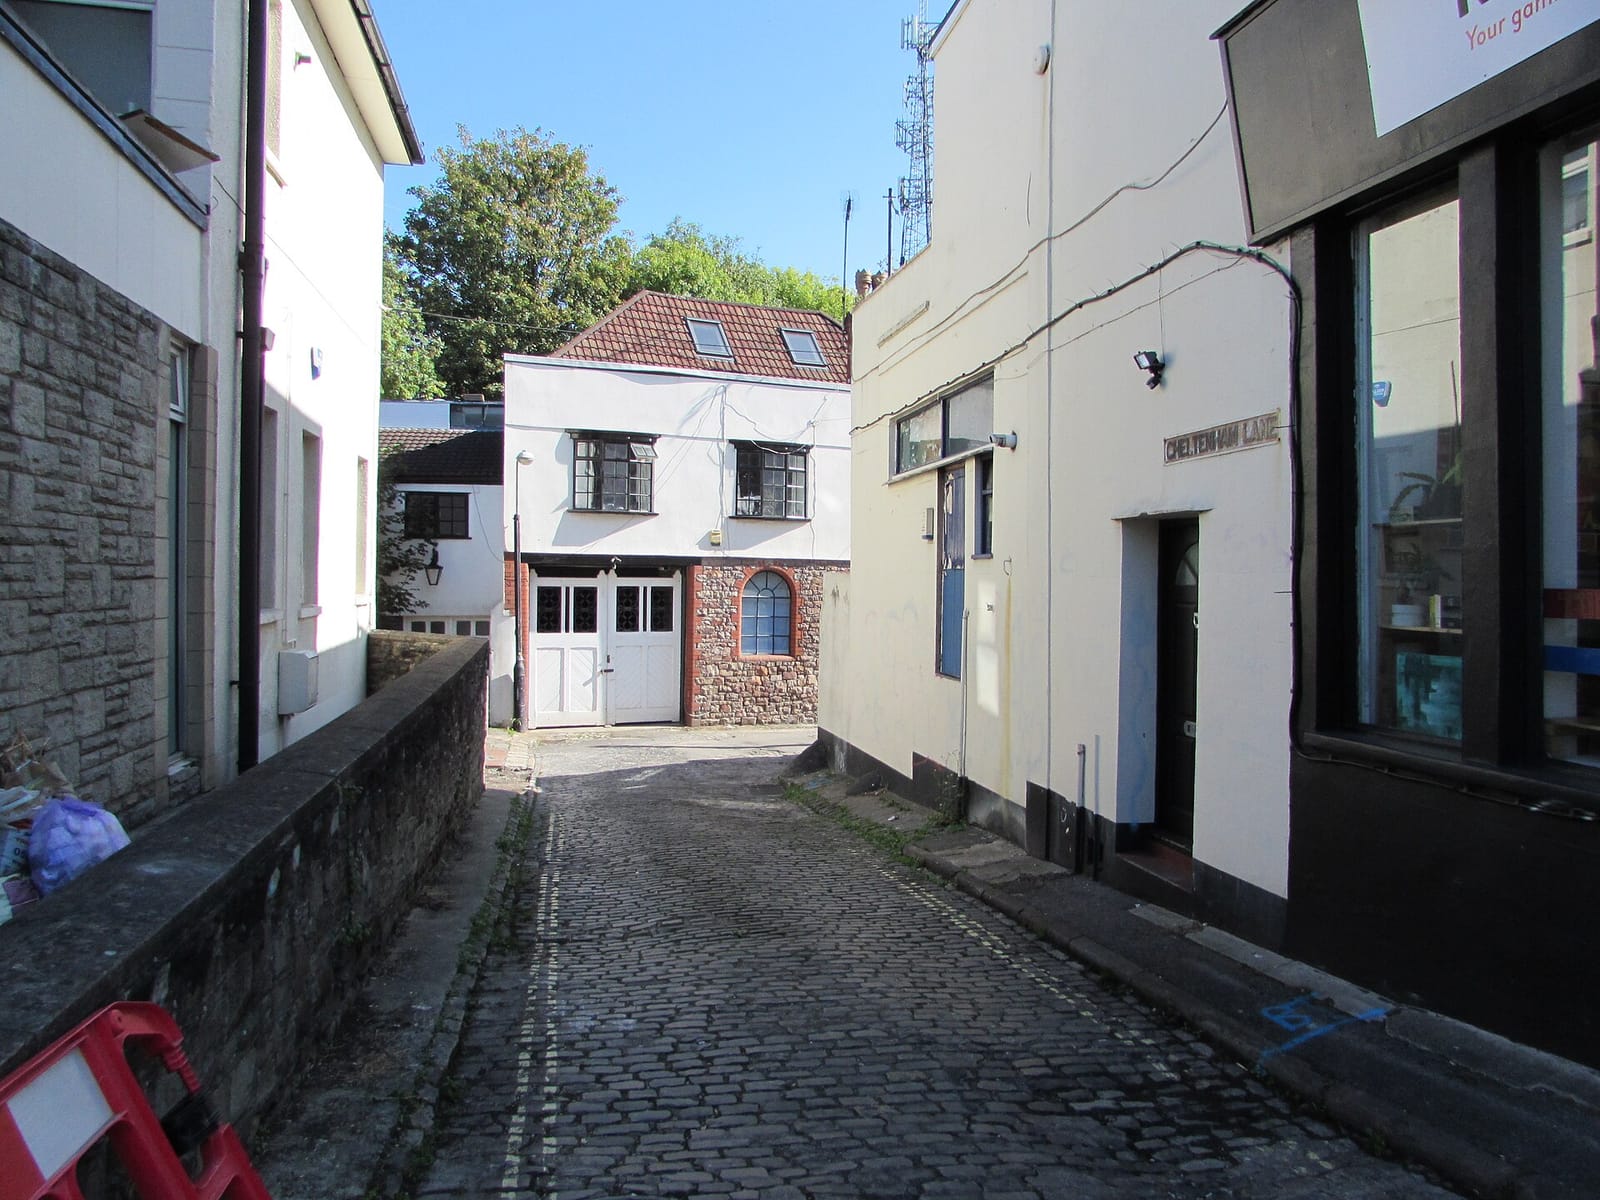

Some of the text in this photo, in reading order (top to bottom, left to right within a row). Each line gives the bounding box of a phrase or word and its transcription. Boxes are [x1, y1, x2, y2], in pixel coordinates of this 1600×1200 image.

[1466, 18, 1505, 50] Your
[1511, 0, 1558, 33] gam
[1166, 414, 1279, 460] CHELTENHAM LANE
